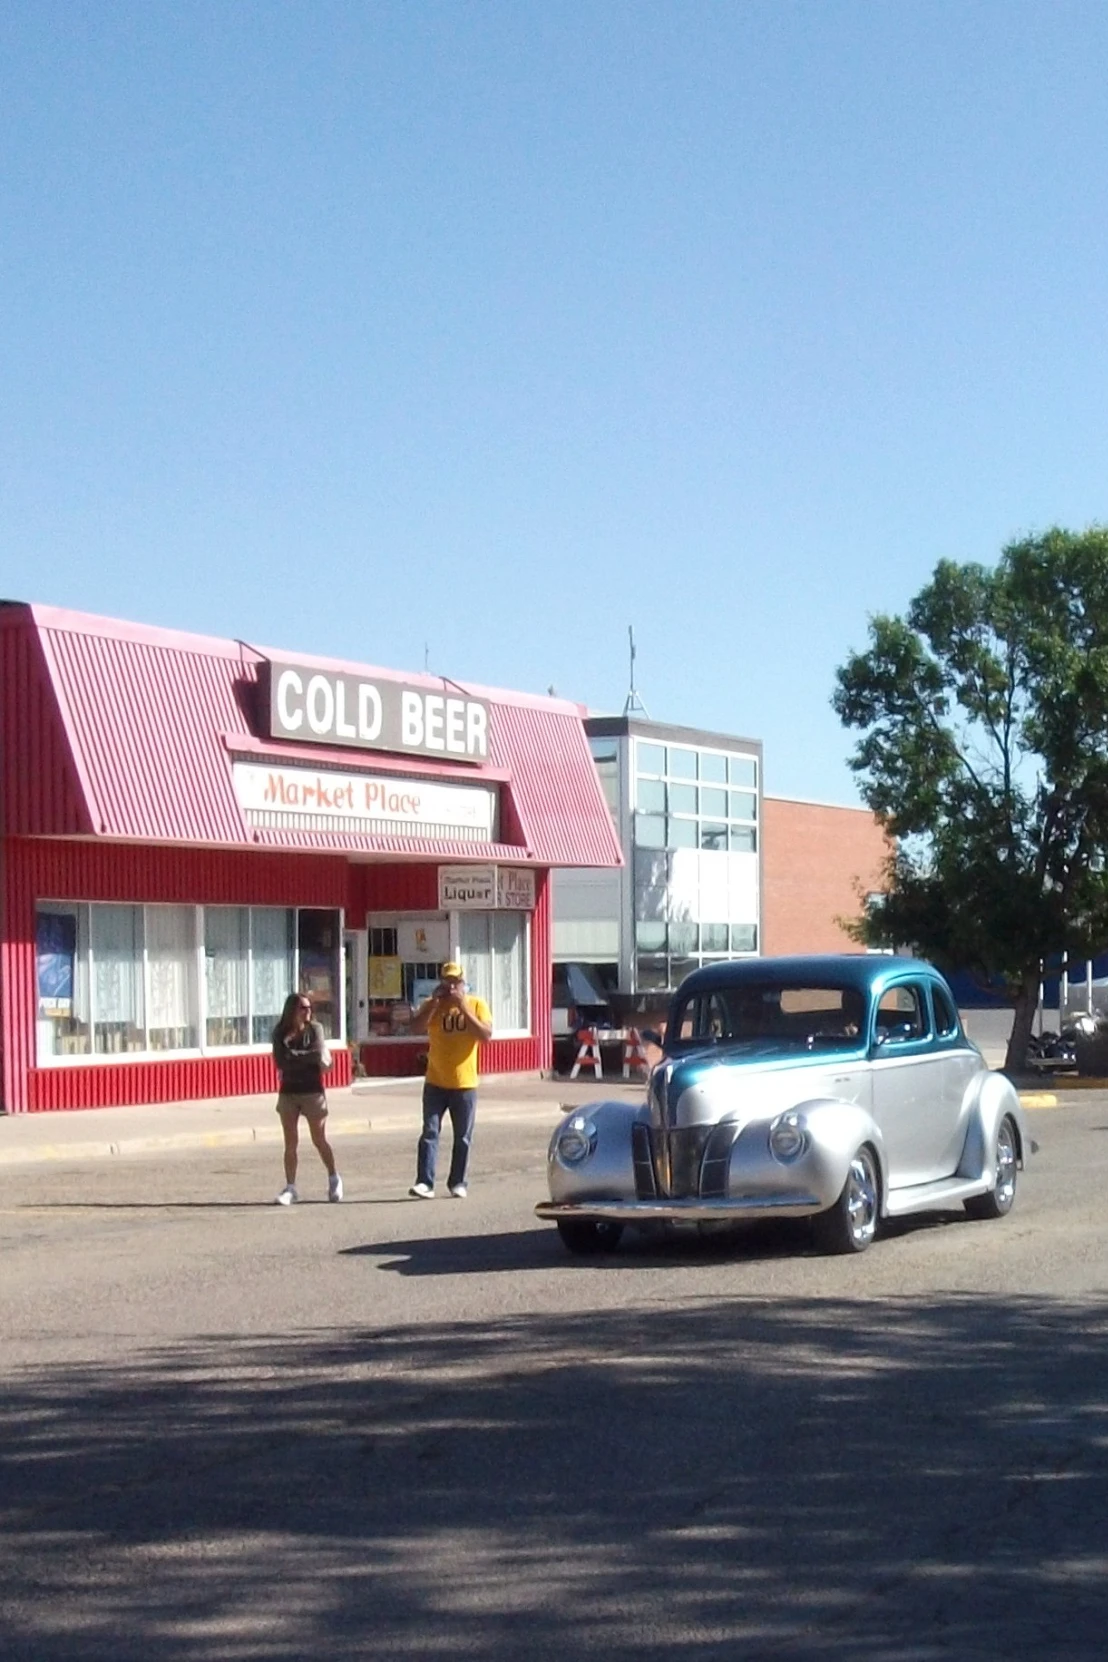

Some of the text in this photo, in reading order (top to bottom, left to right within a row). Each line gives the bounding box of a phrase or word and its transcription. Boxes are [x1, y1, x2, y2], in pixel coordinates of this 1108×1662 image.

[277, 670, 487, 756] COLD BEER
[264, 773, 354, 809] Market
[365, 783, 421, 814] Place
[444, 885, 492, 902] Liquor
